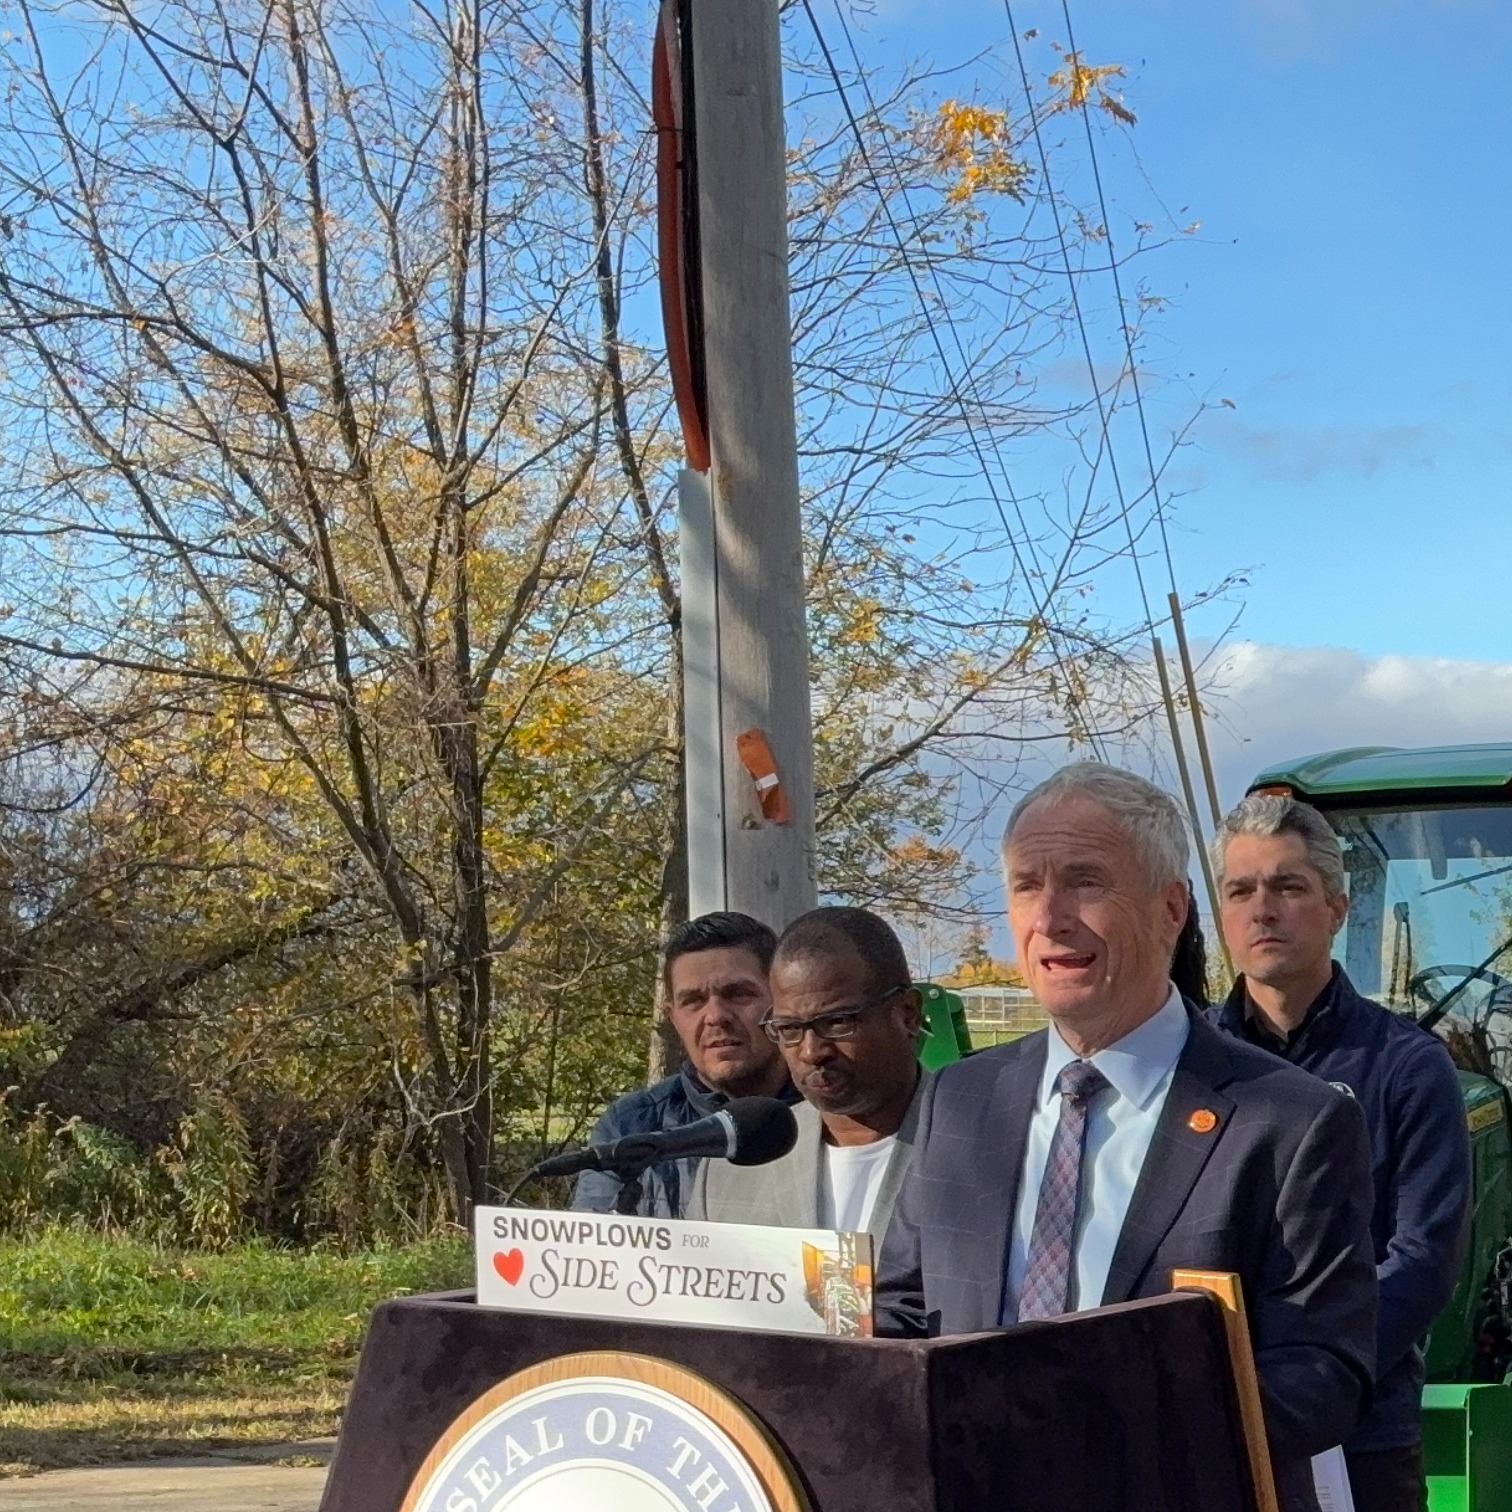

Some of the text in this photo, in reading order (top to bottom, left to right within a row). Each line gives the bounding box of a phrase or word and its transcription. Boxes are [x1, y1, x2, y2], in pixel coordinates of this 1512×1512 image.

[493, 1215, 710, 1250] SNOWPLOWS FOR
[529, 1248, 786, 1307] SIDE STREETS
[584, 1406, 654, 1452] OF
